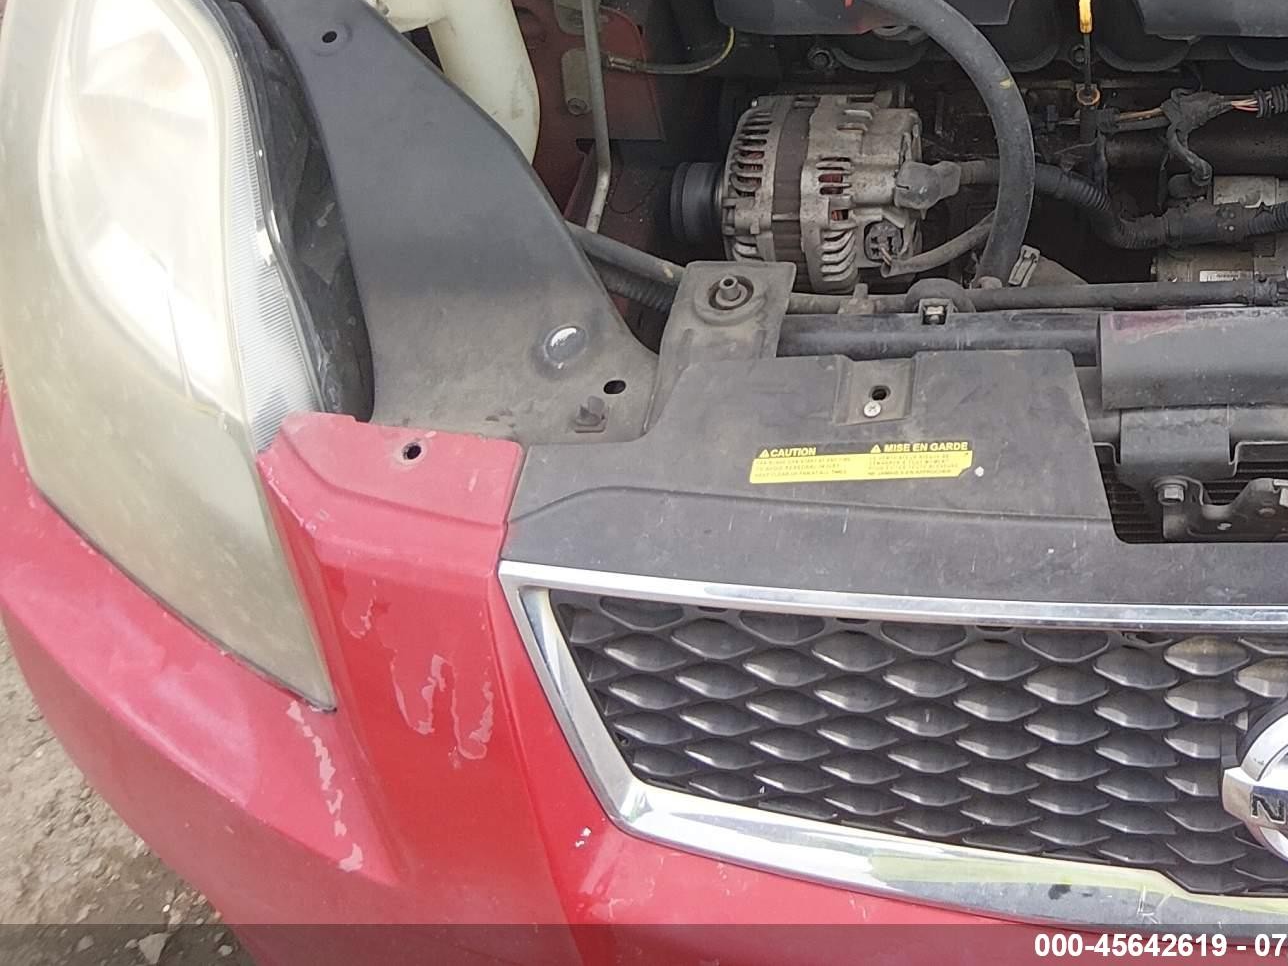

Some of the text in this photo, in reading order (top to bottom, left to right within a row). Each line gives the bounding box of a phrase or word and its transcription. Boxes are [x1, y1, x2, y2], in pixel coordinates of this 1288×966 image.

[770, 446, 817, 458] CAUTION
[884, 441, 969, 453] MISE EN GARDE
